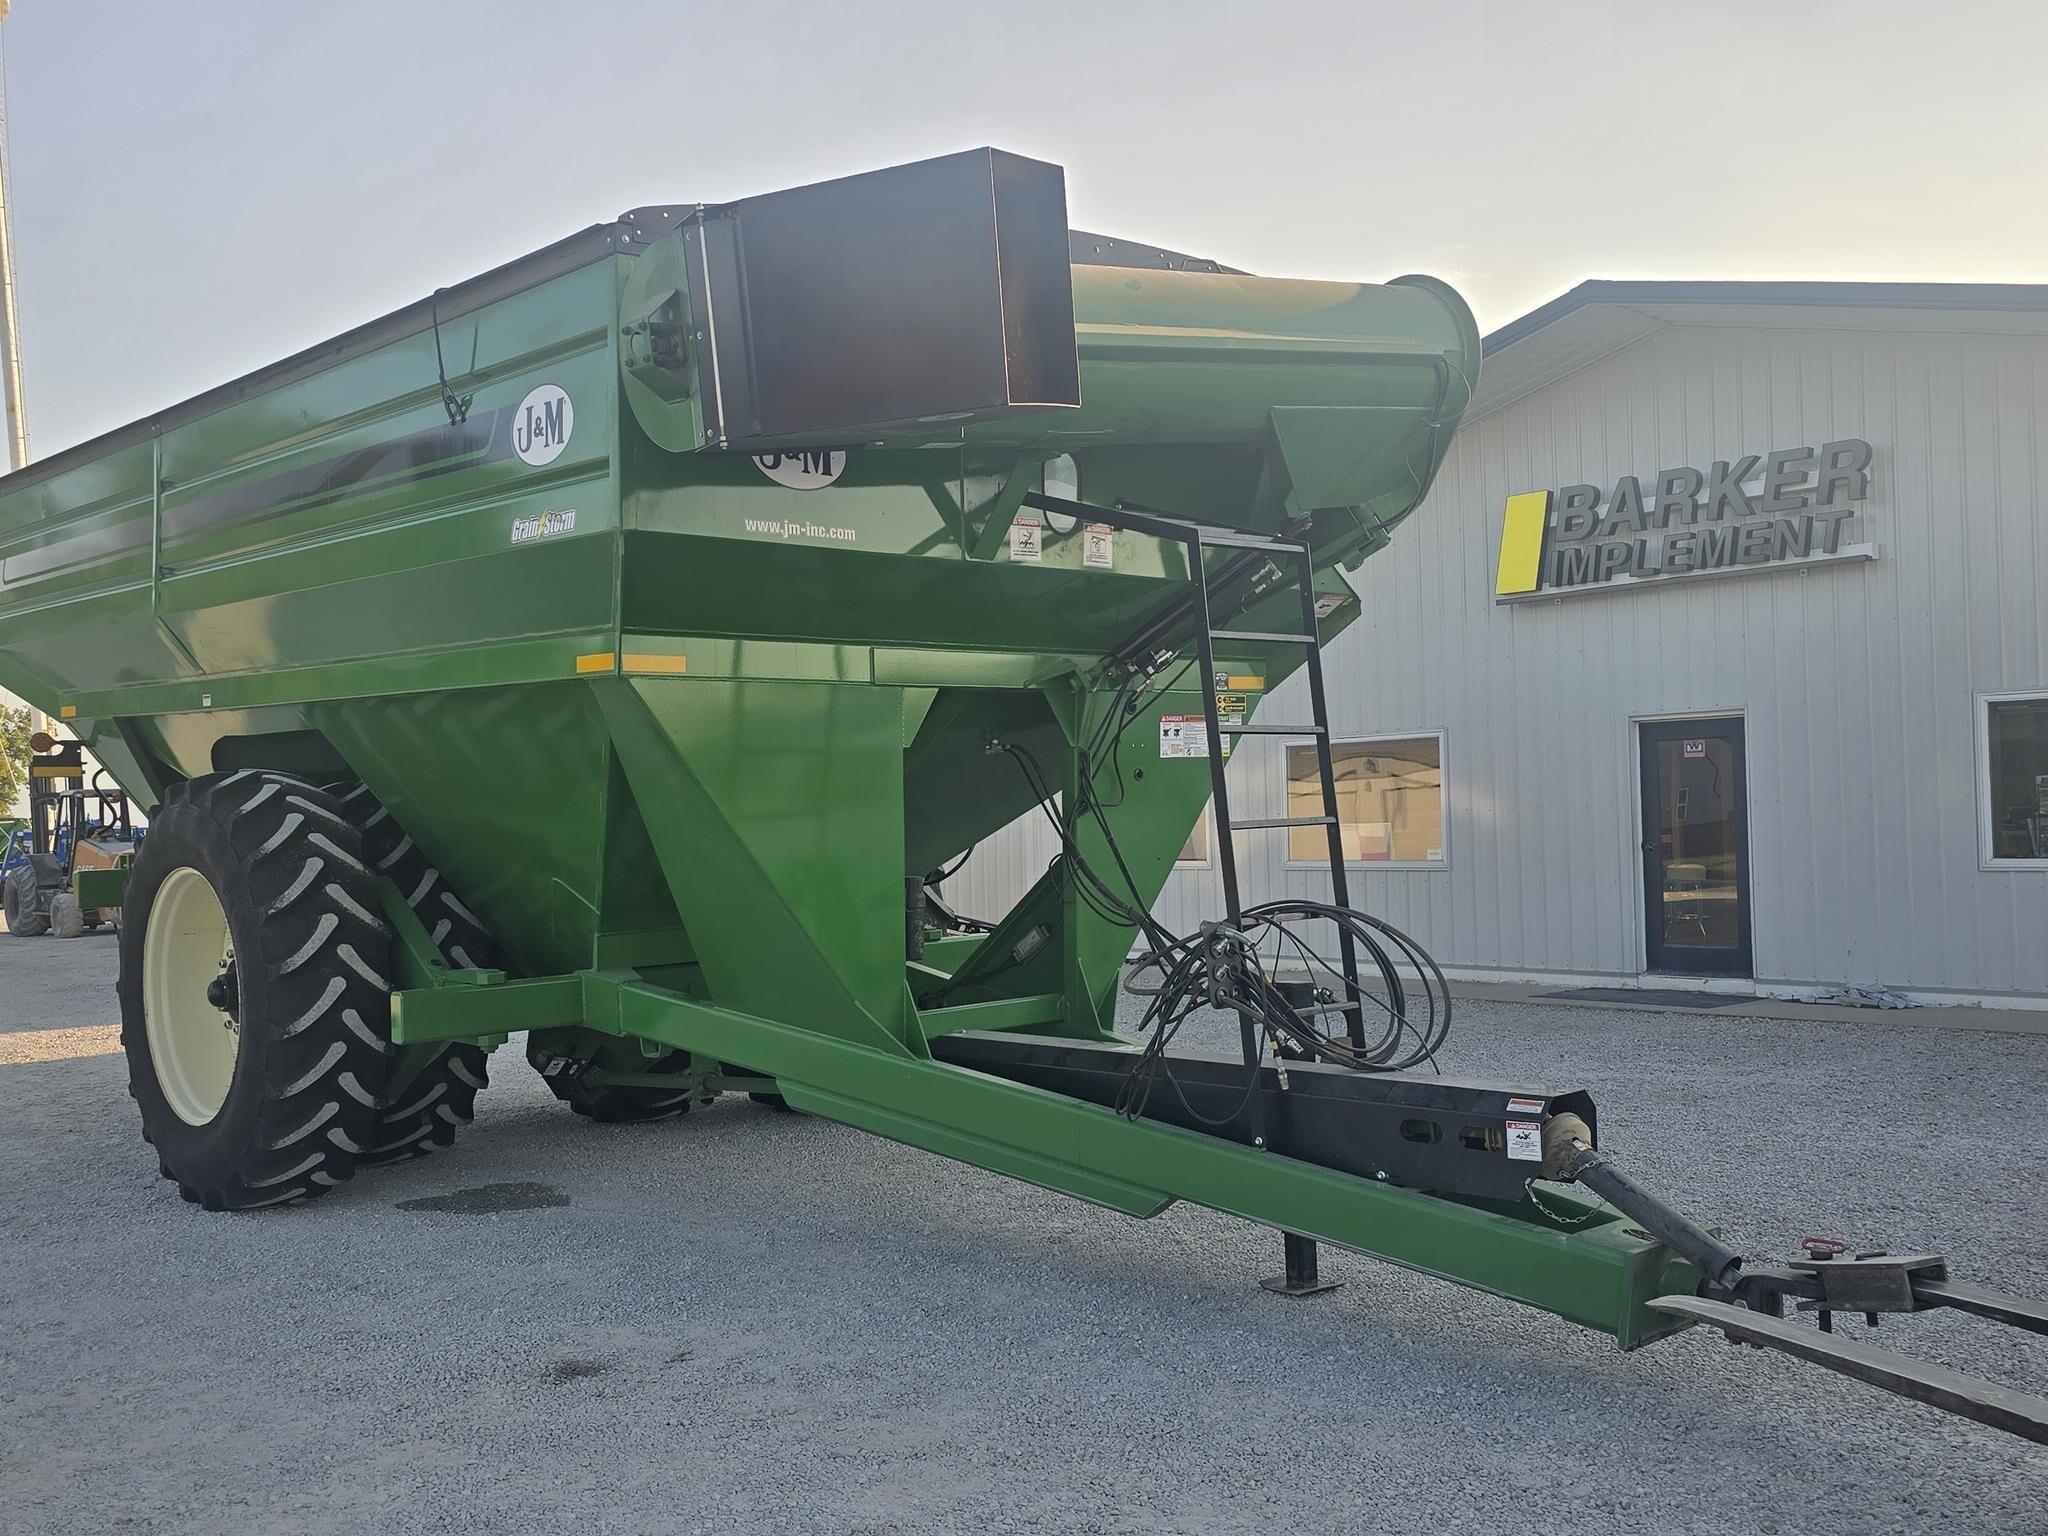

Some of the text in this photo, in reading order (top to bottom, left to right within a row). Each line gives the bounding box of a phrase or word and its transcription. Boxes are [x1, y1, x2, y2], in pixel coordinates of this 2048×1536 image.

[517, 397, 565, 454] J&M
[1555, 438, 1873, 542] BARKER
[512, 510, 574, 541] Grain Storm
[744, 518, 856, 540] www.jm-inc.com
[1550, 510, 1854, 588] IMPLEMENT
